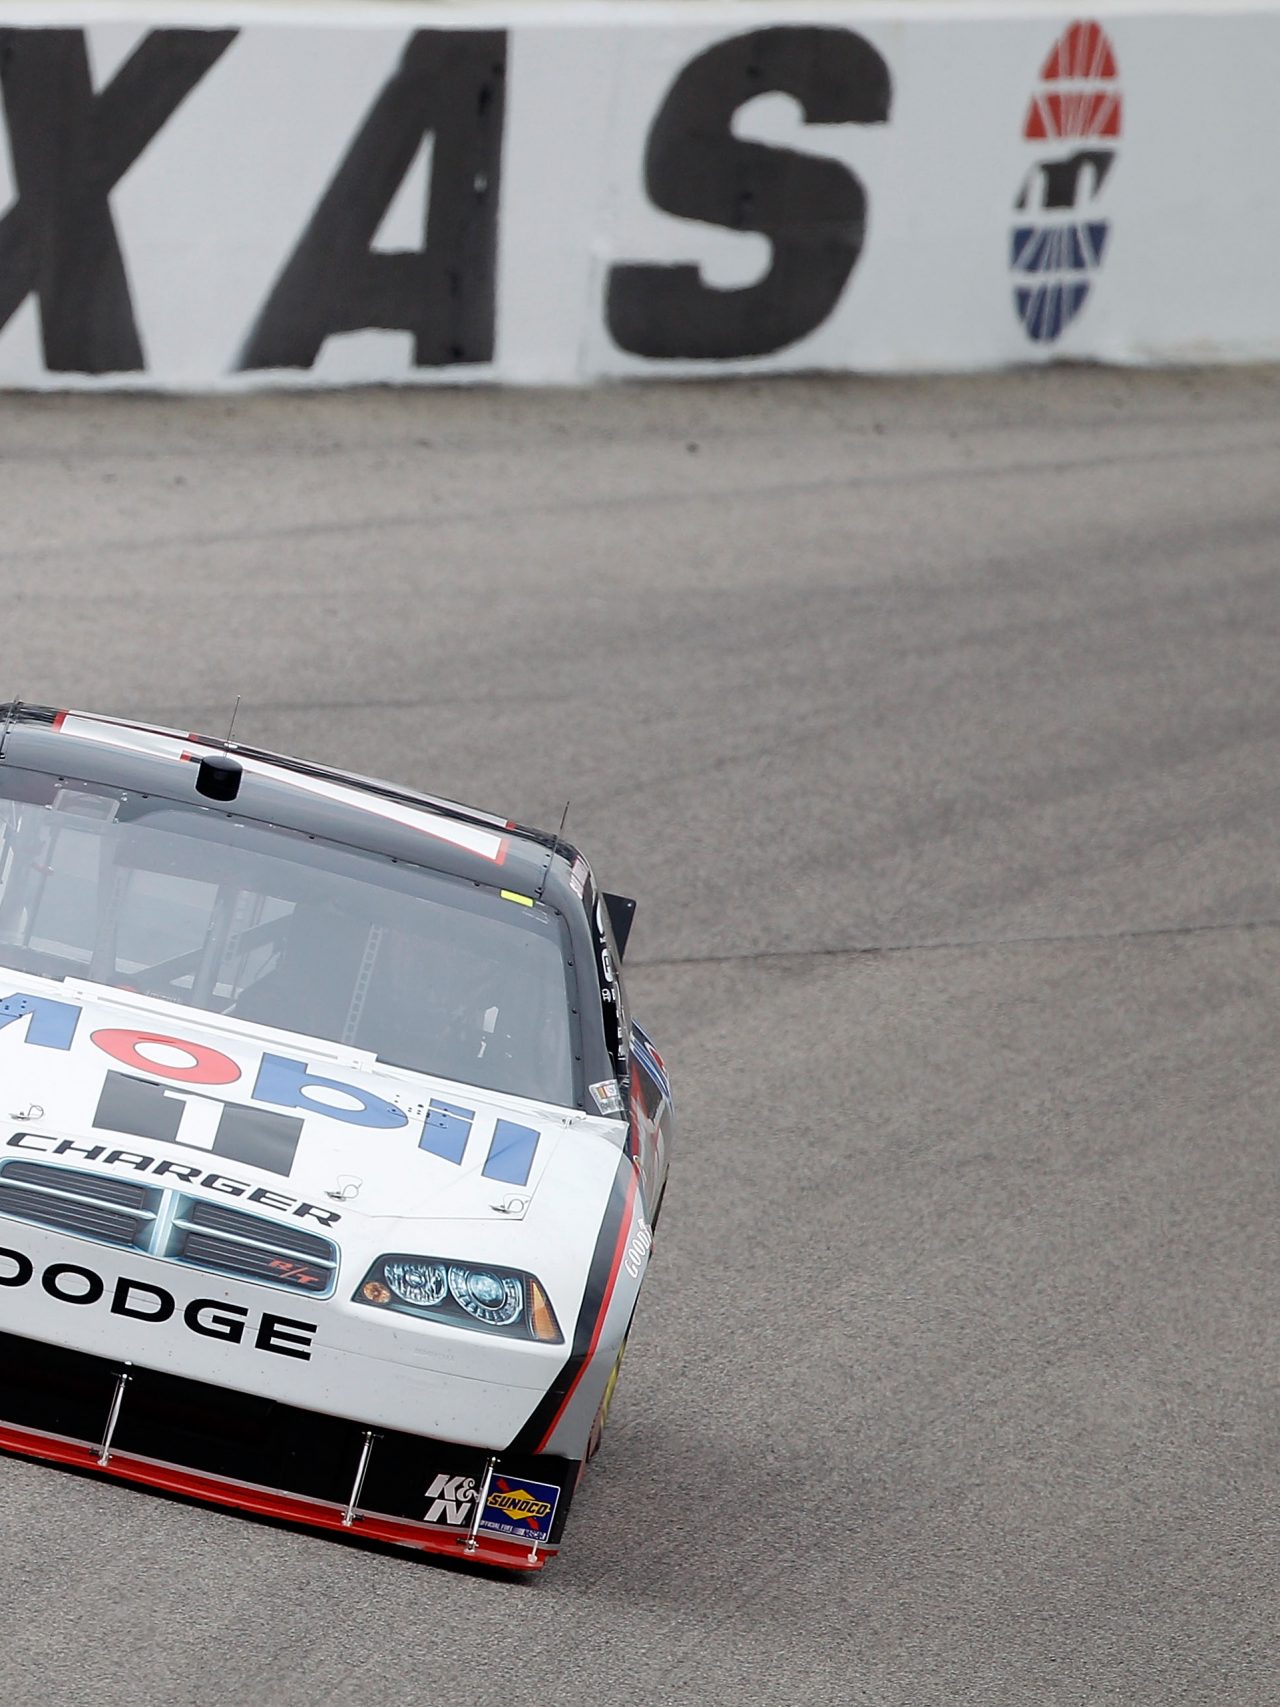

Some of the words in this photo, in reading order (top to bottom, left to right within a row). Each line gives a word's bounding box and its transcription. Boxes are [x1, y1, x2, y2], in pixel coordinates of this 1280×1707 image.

[5, 1132, 342, 1228] CHARGER
[271, 1259, 319, 1284] R/T
[488, 1494, 549, 1516] SUNOCO
